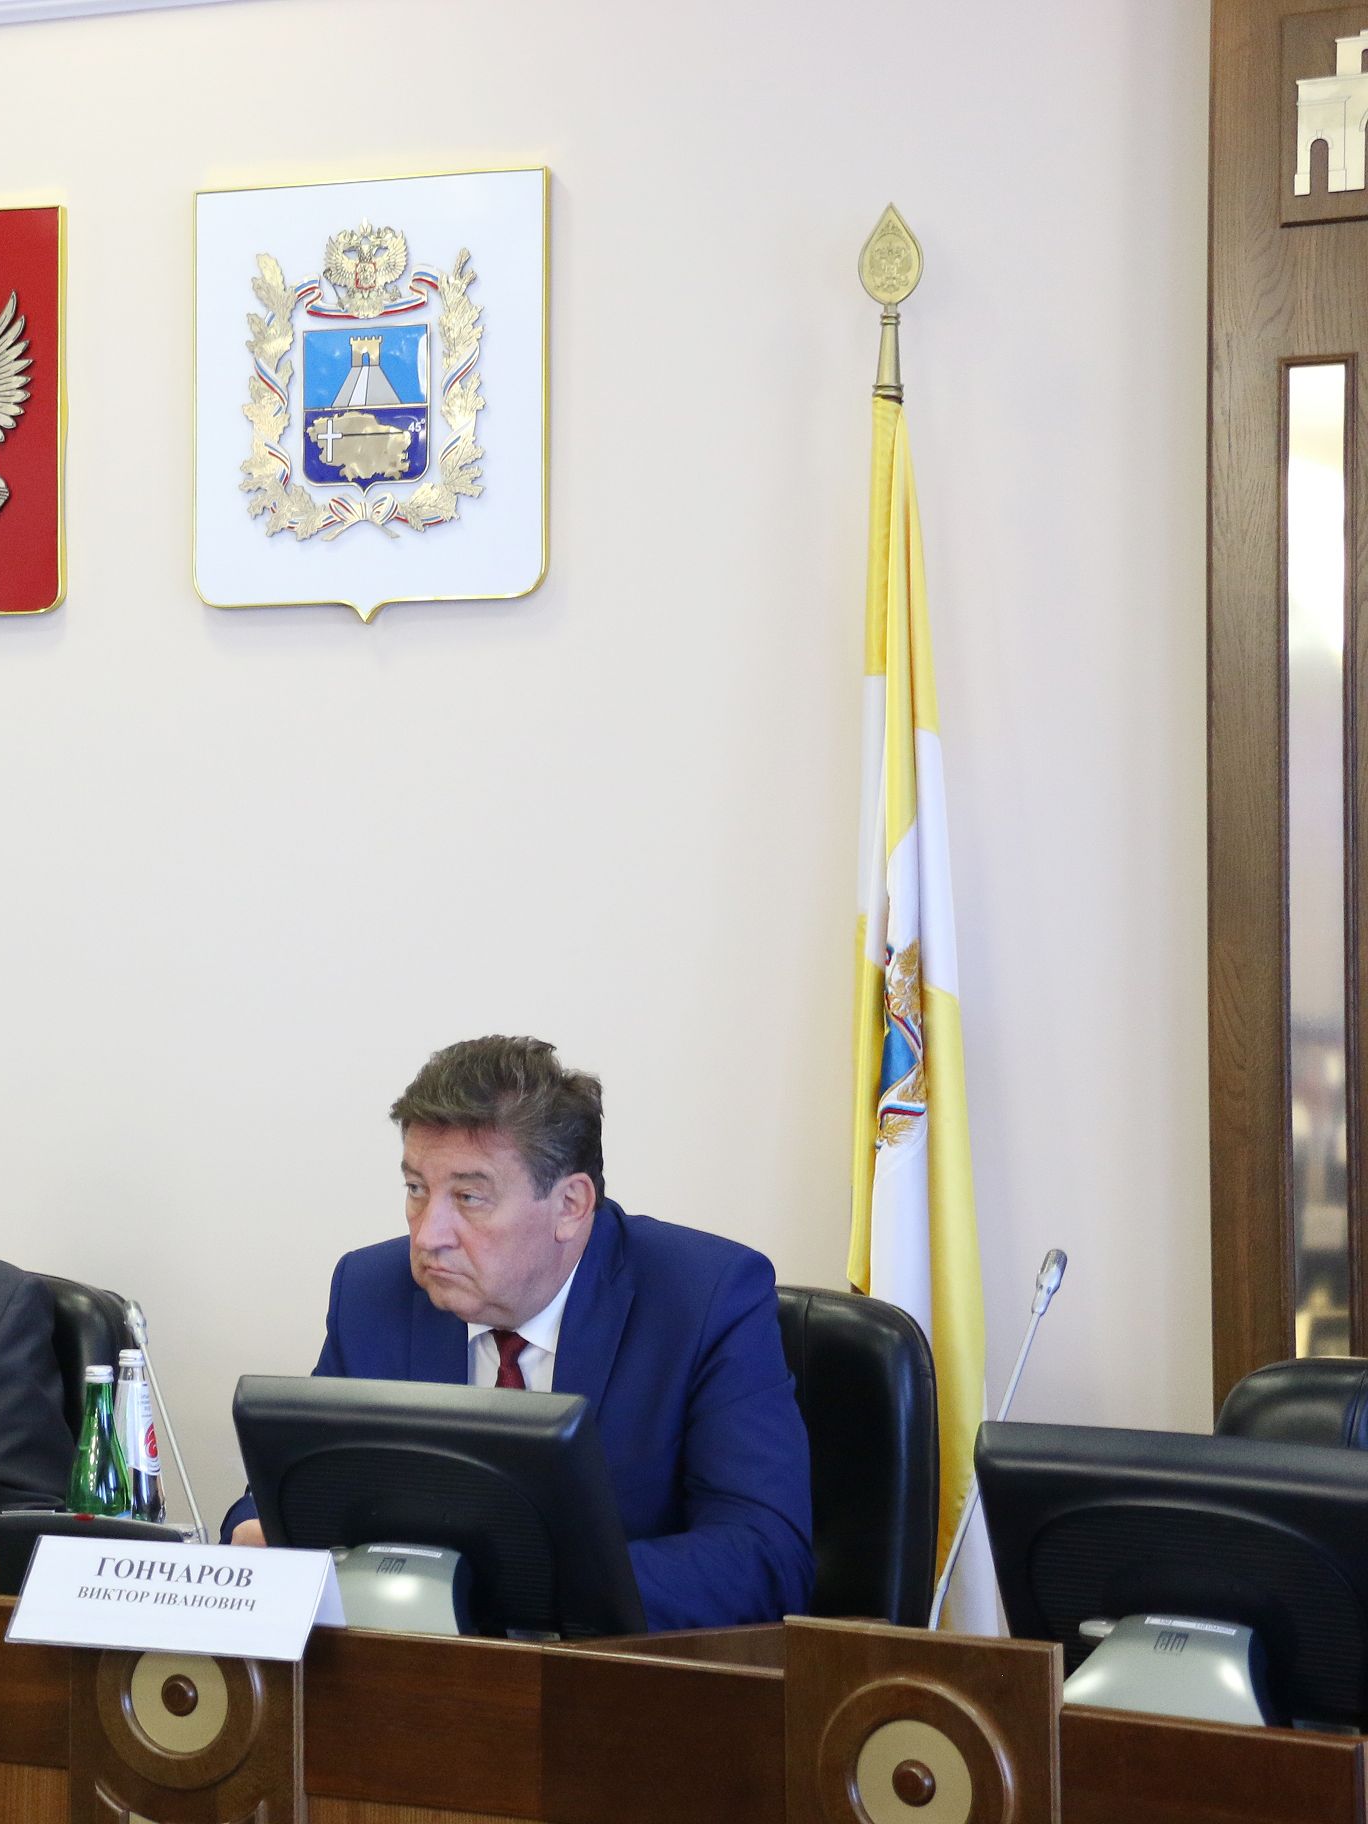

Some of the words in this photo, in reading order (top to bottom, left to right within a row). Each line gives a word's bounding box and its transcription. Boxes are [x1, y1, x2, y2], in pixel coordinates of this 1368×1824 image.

[95, 1556, 254, 1588] ГОНЧАРОВ
[76, 1585, 151, 1605] ВИКТОР
[153, 1594, 256, 1612] ИВАНОВИЧ
